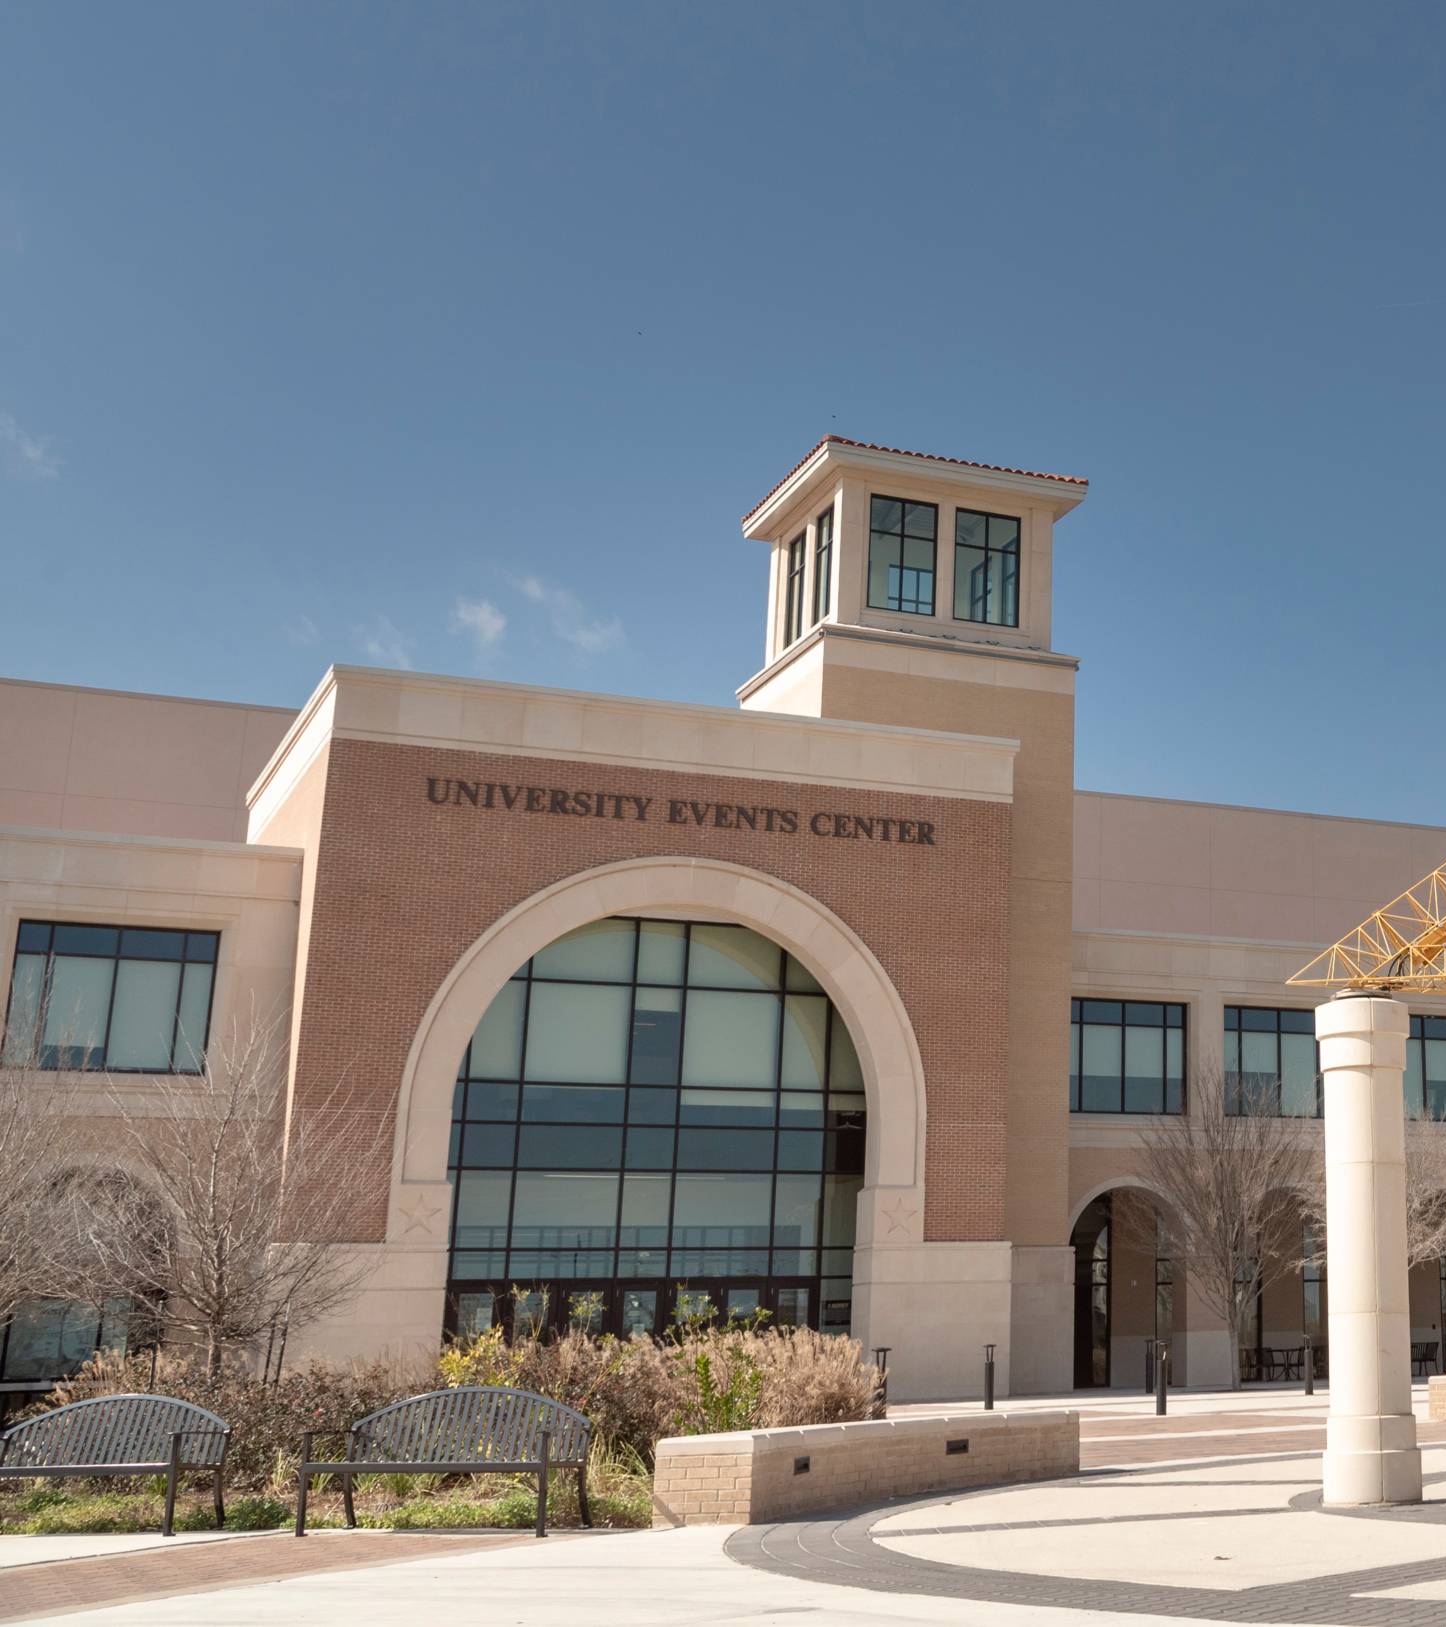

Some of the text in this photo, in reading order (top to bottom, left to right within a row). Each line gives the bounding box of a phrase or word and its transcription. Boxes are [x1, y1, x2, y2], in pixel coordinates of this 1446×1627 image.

[428, 777, 935, 846] UNIVERSITY EVENTS CENTER
